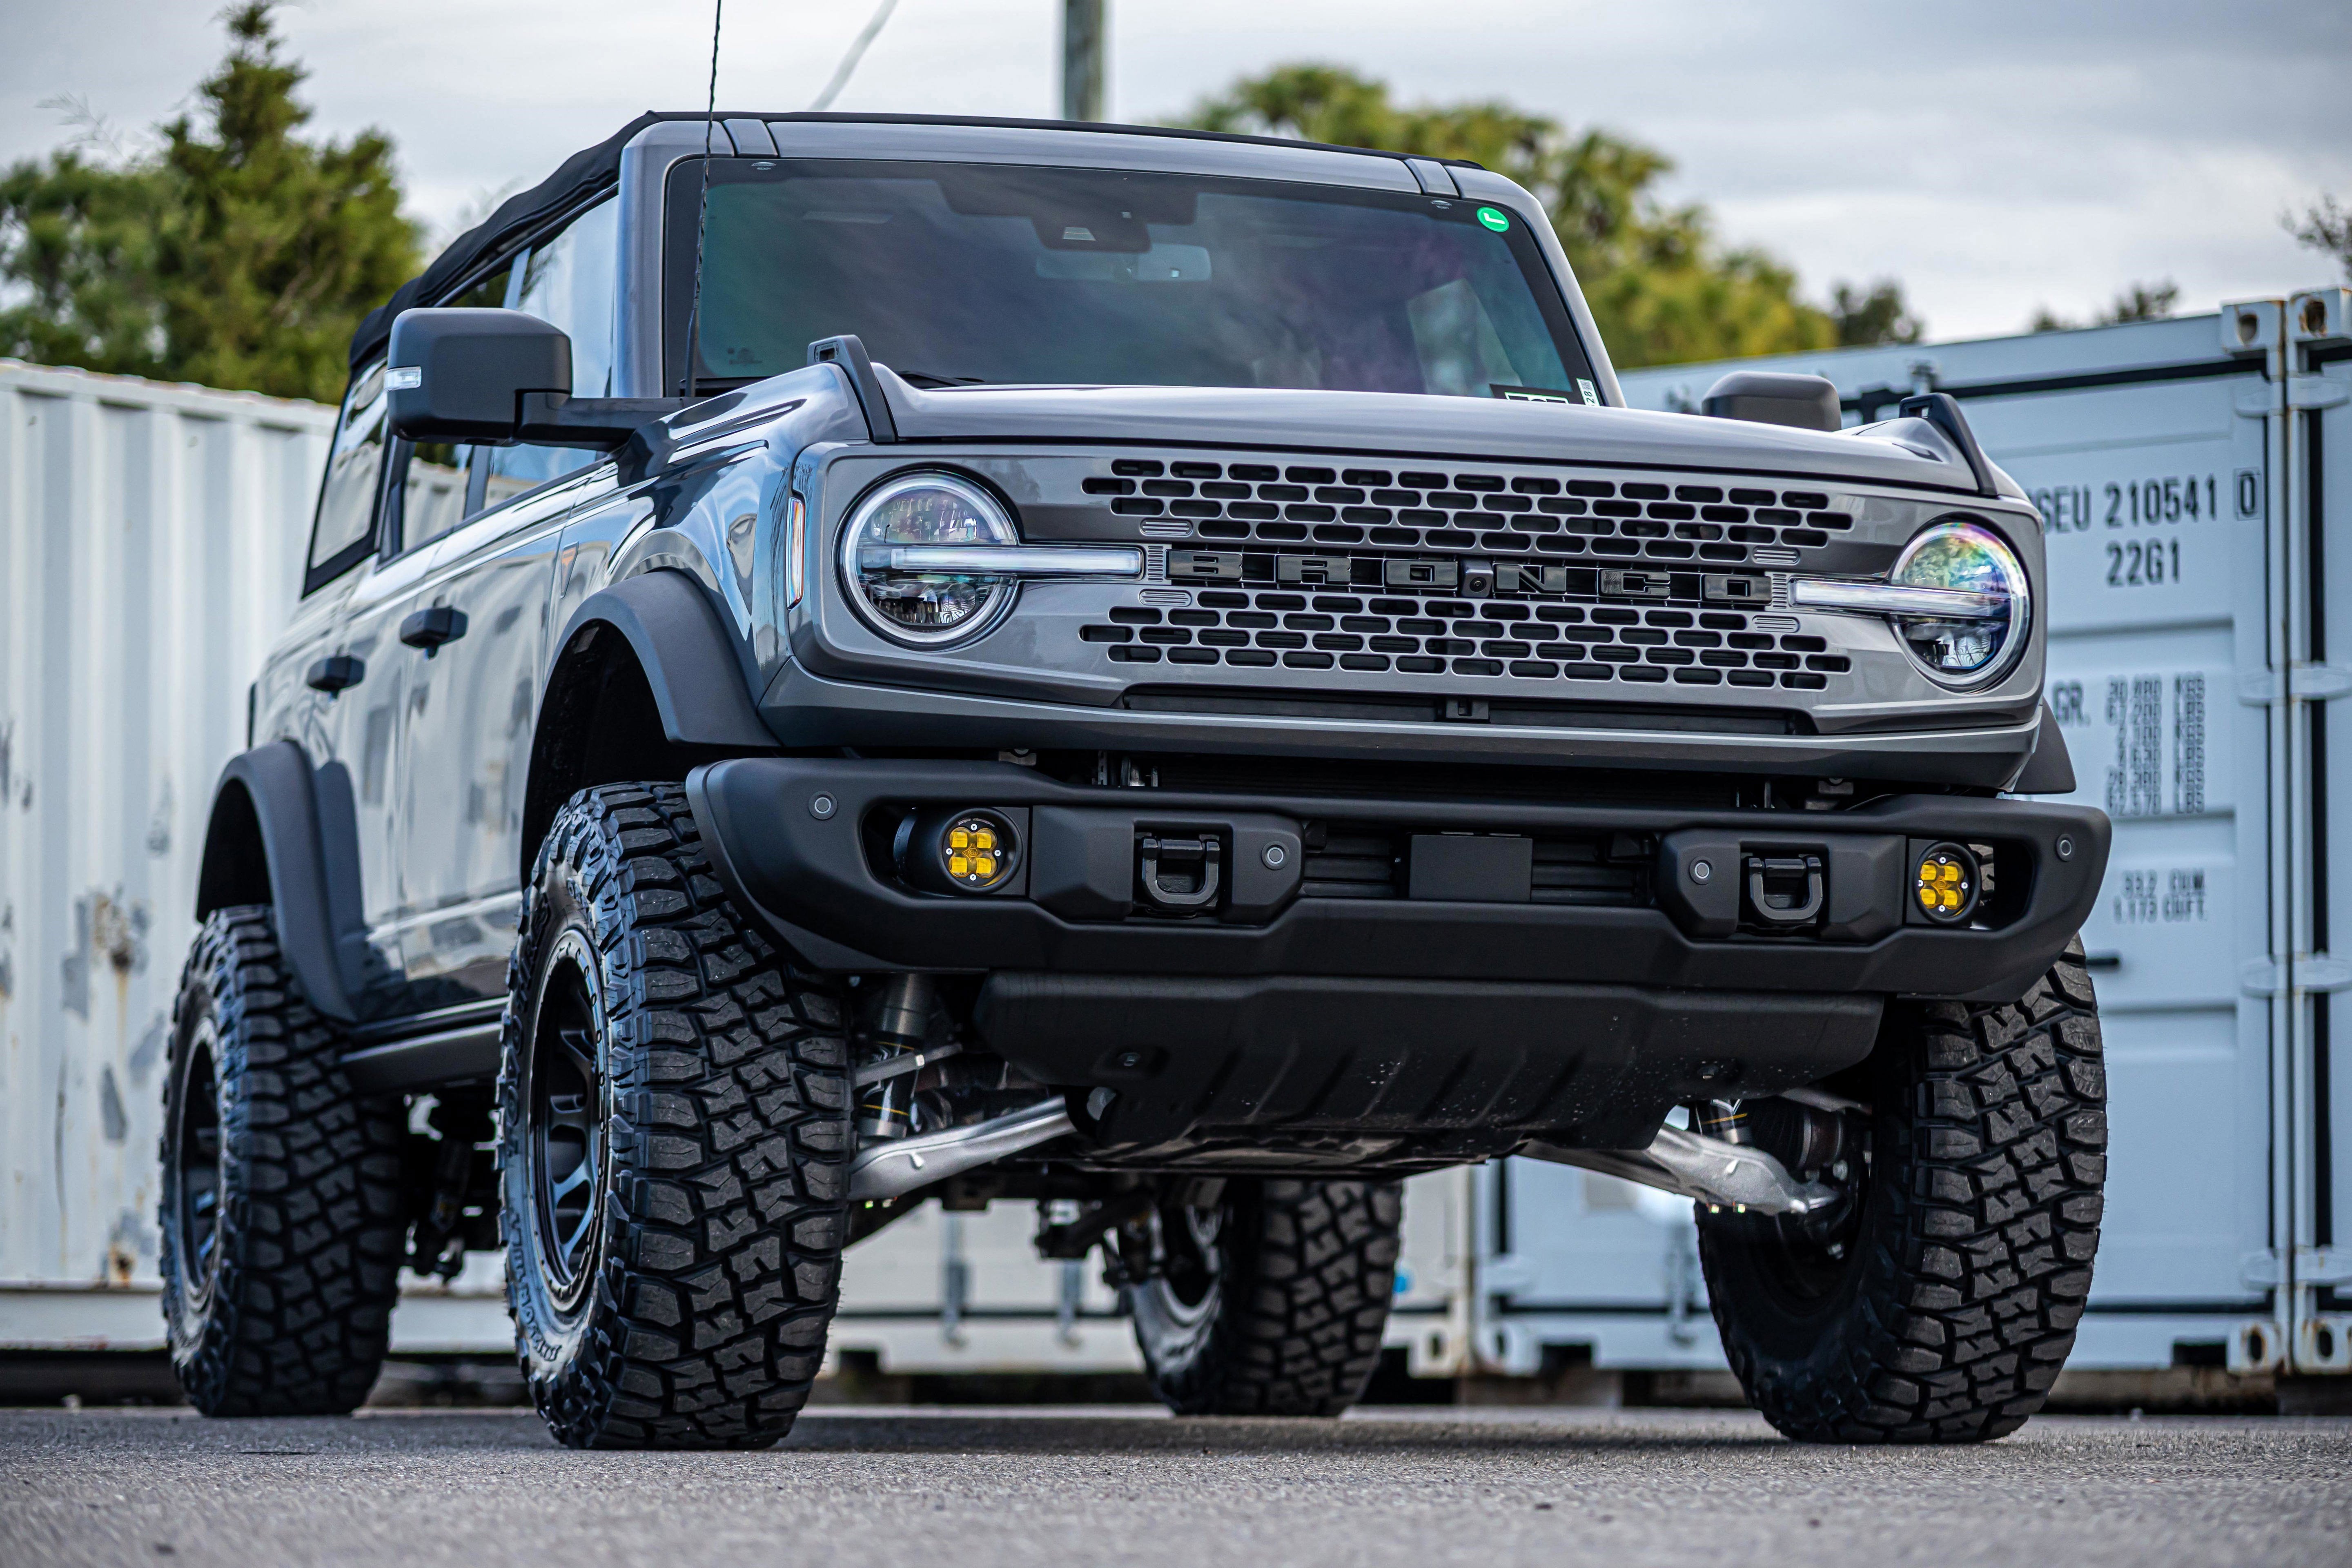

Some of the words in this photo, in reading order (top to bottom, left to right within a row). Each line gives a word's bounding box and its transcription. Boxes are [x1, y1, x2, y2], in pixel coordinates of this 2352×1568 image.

[2025, 483, 2092, 534] SEU
[2104, 473, 2217, 530] 210541
[1166, 549, 1773, 604] BRONCO
[2107, 537, 2181, 587] 22G1
